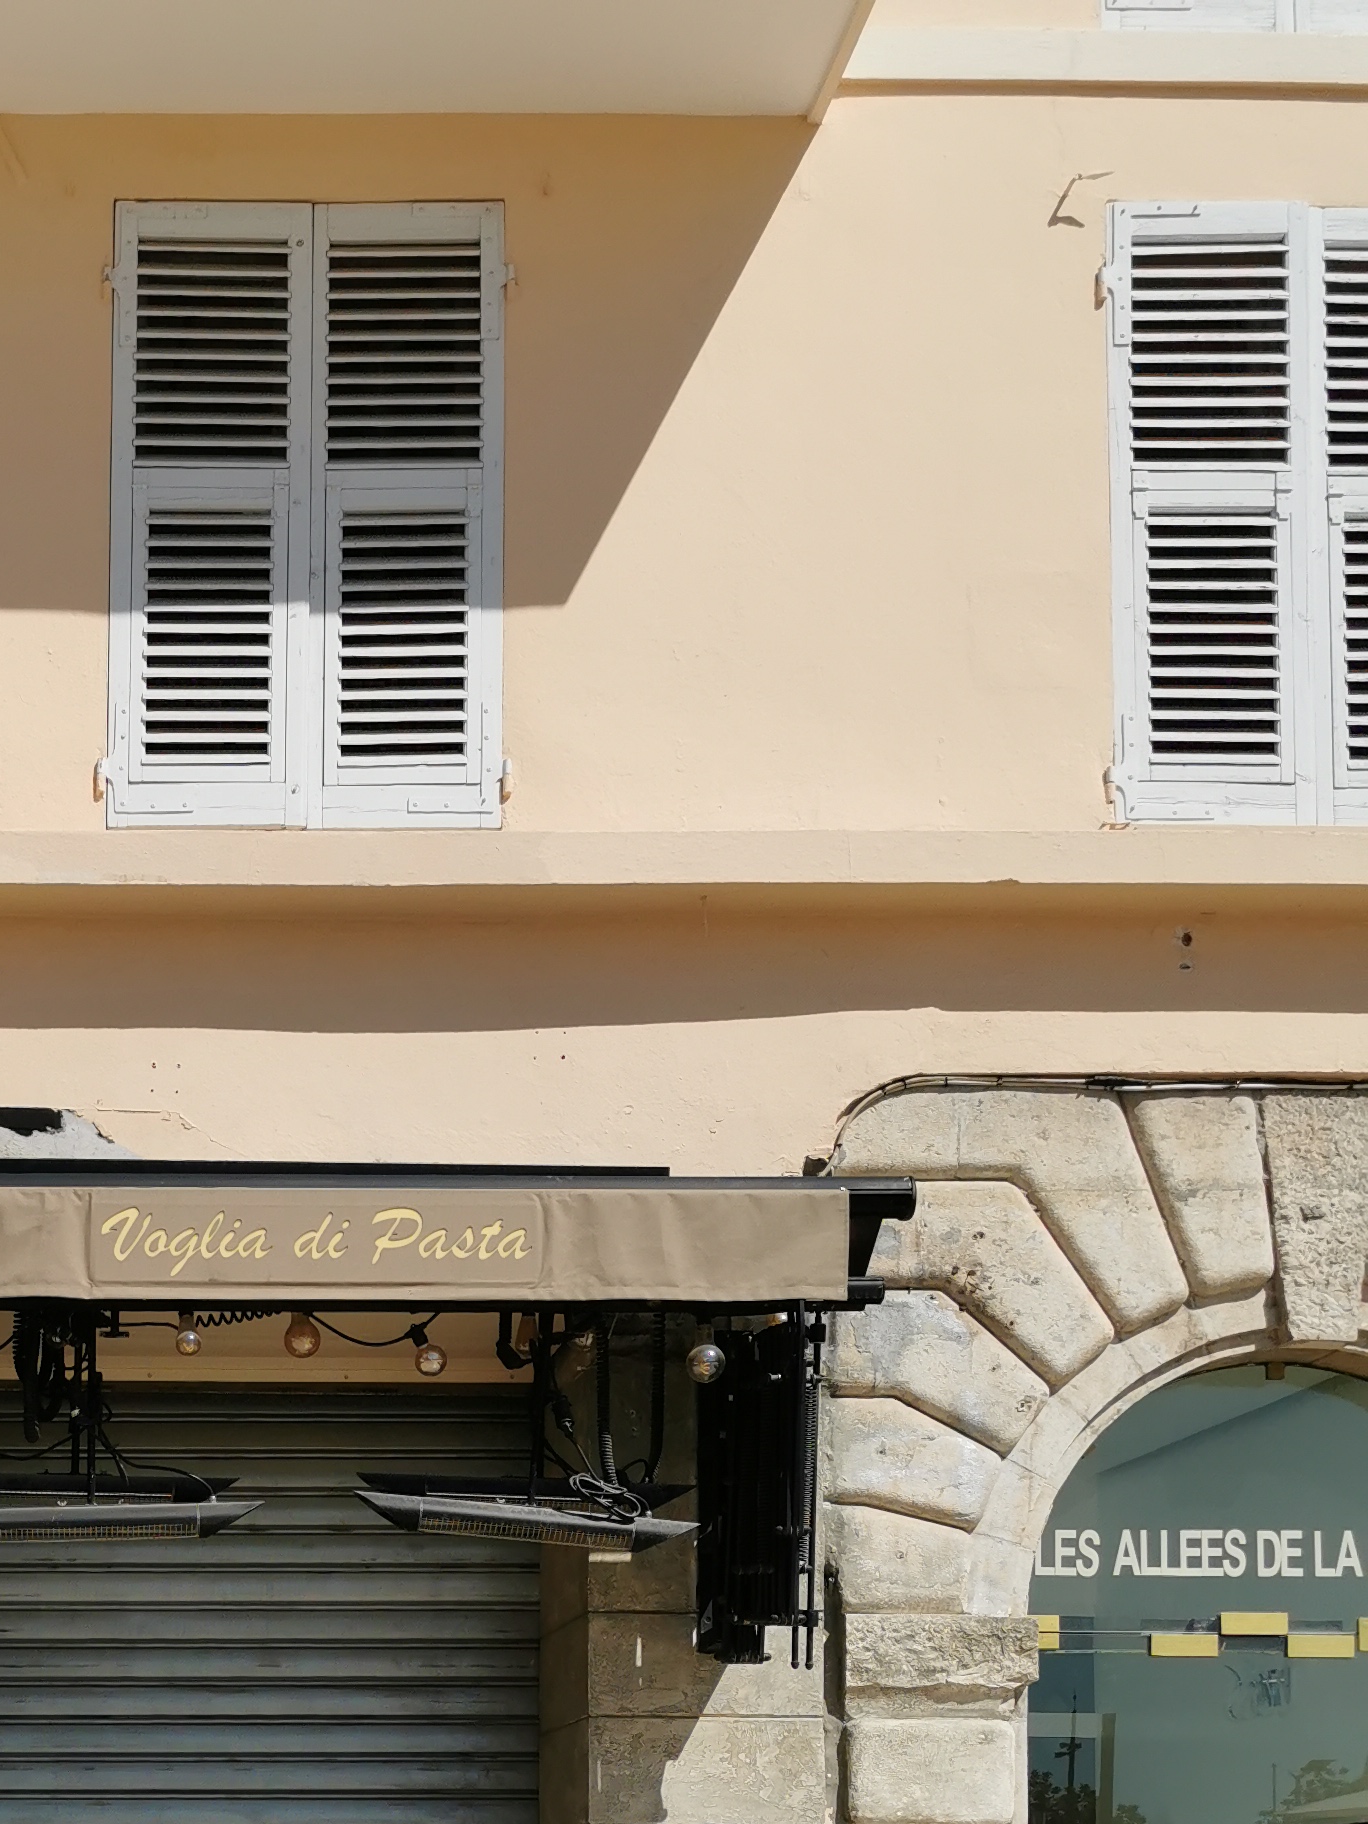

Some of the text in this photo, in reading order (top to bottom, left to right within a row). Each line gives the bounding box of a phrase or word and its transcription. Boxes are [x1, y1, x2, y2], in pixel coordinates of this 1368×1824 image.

[102, 1206, 533, 1277] Voglia di Pasta
[1035, 1528, 1364, 1577] LES ALLEES DE LA
